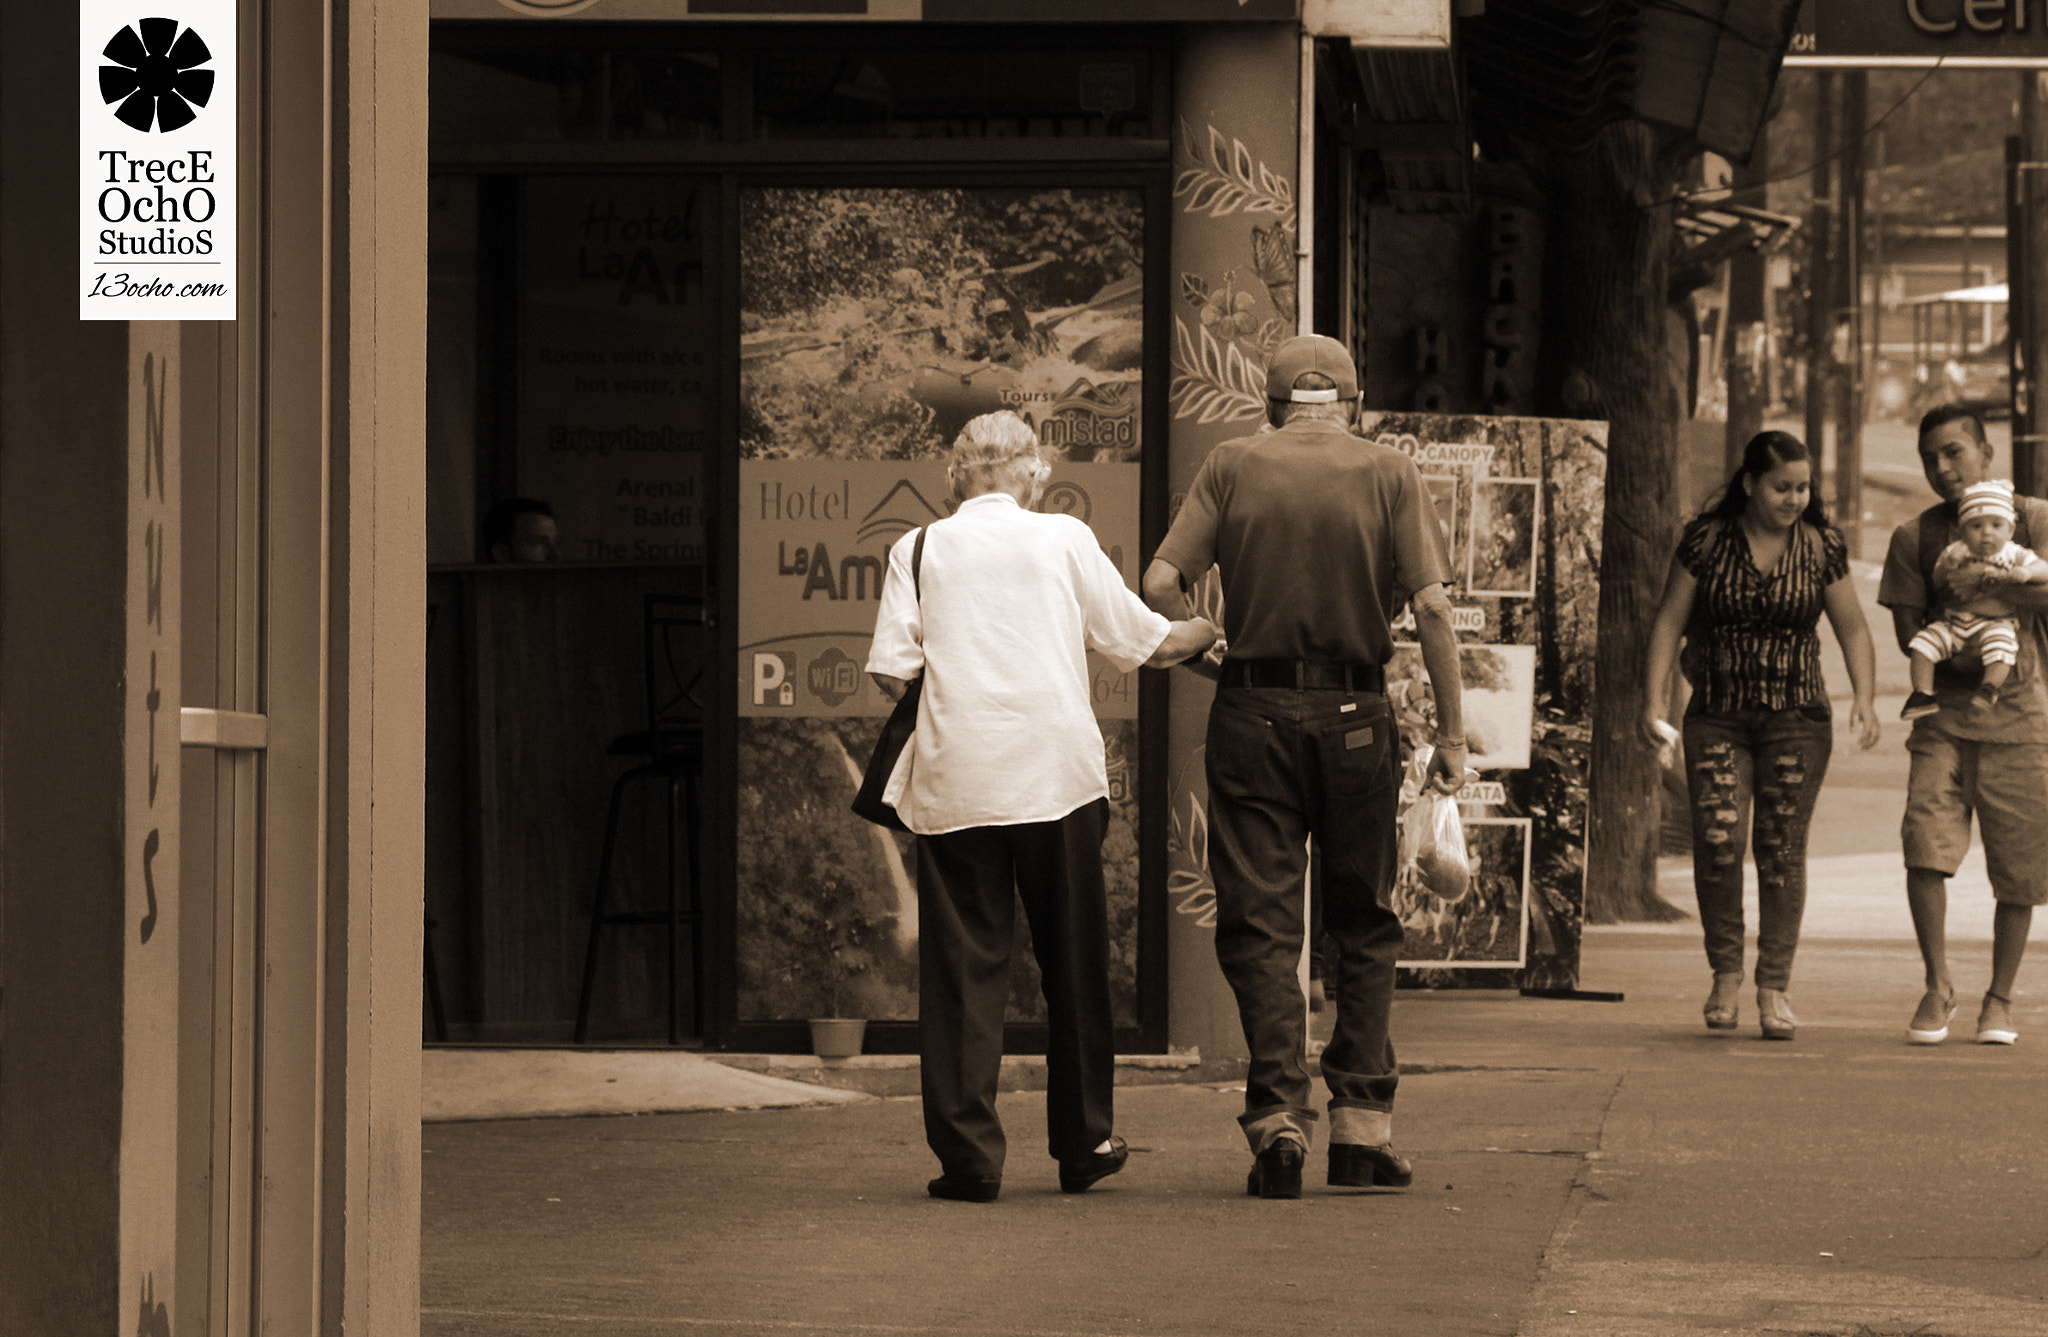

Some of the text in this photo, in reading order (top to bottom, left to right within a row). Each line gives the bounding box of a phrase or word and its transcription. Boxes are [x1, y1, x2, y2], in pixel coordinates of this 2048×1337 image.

[578, 189, 697, 244] Hotel
[578, 246, 624, 280] La
[1483, 209, 1525, 412] BACK
[611, 346, 655, 365] with
[680, 378, 702, 393] ca
[1000, 389, 1048, 402] Tours
[1426, 446, 1492, 462] CANOPY
[616, 477, 694, 497] Arenal
[760, 480, 850, 521] Hotel
[633, 506, 692, 527] Baldi
[583, 539, 627, 560] The
[778, 541, 892, 600] La Am
